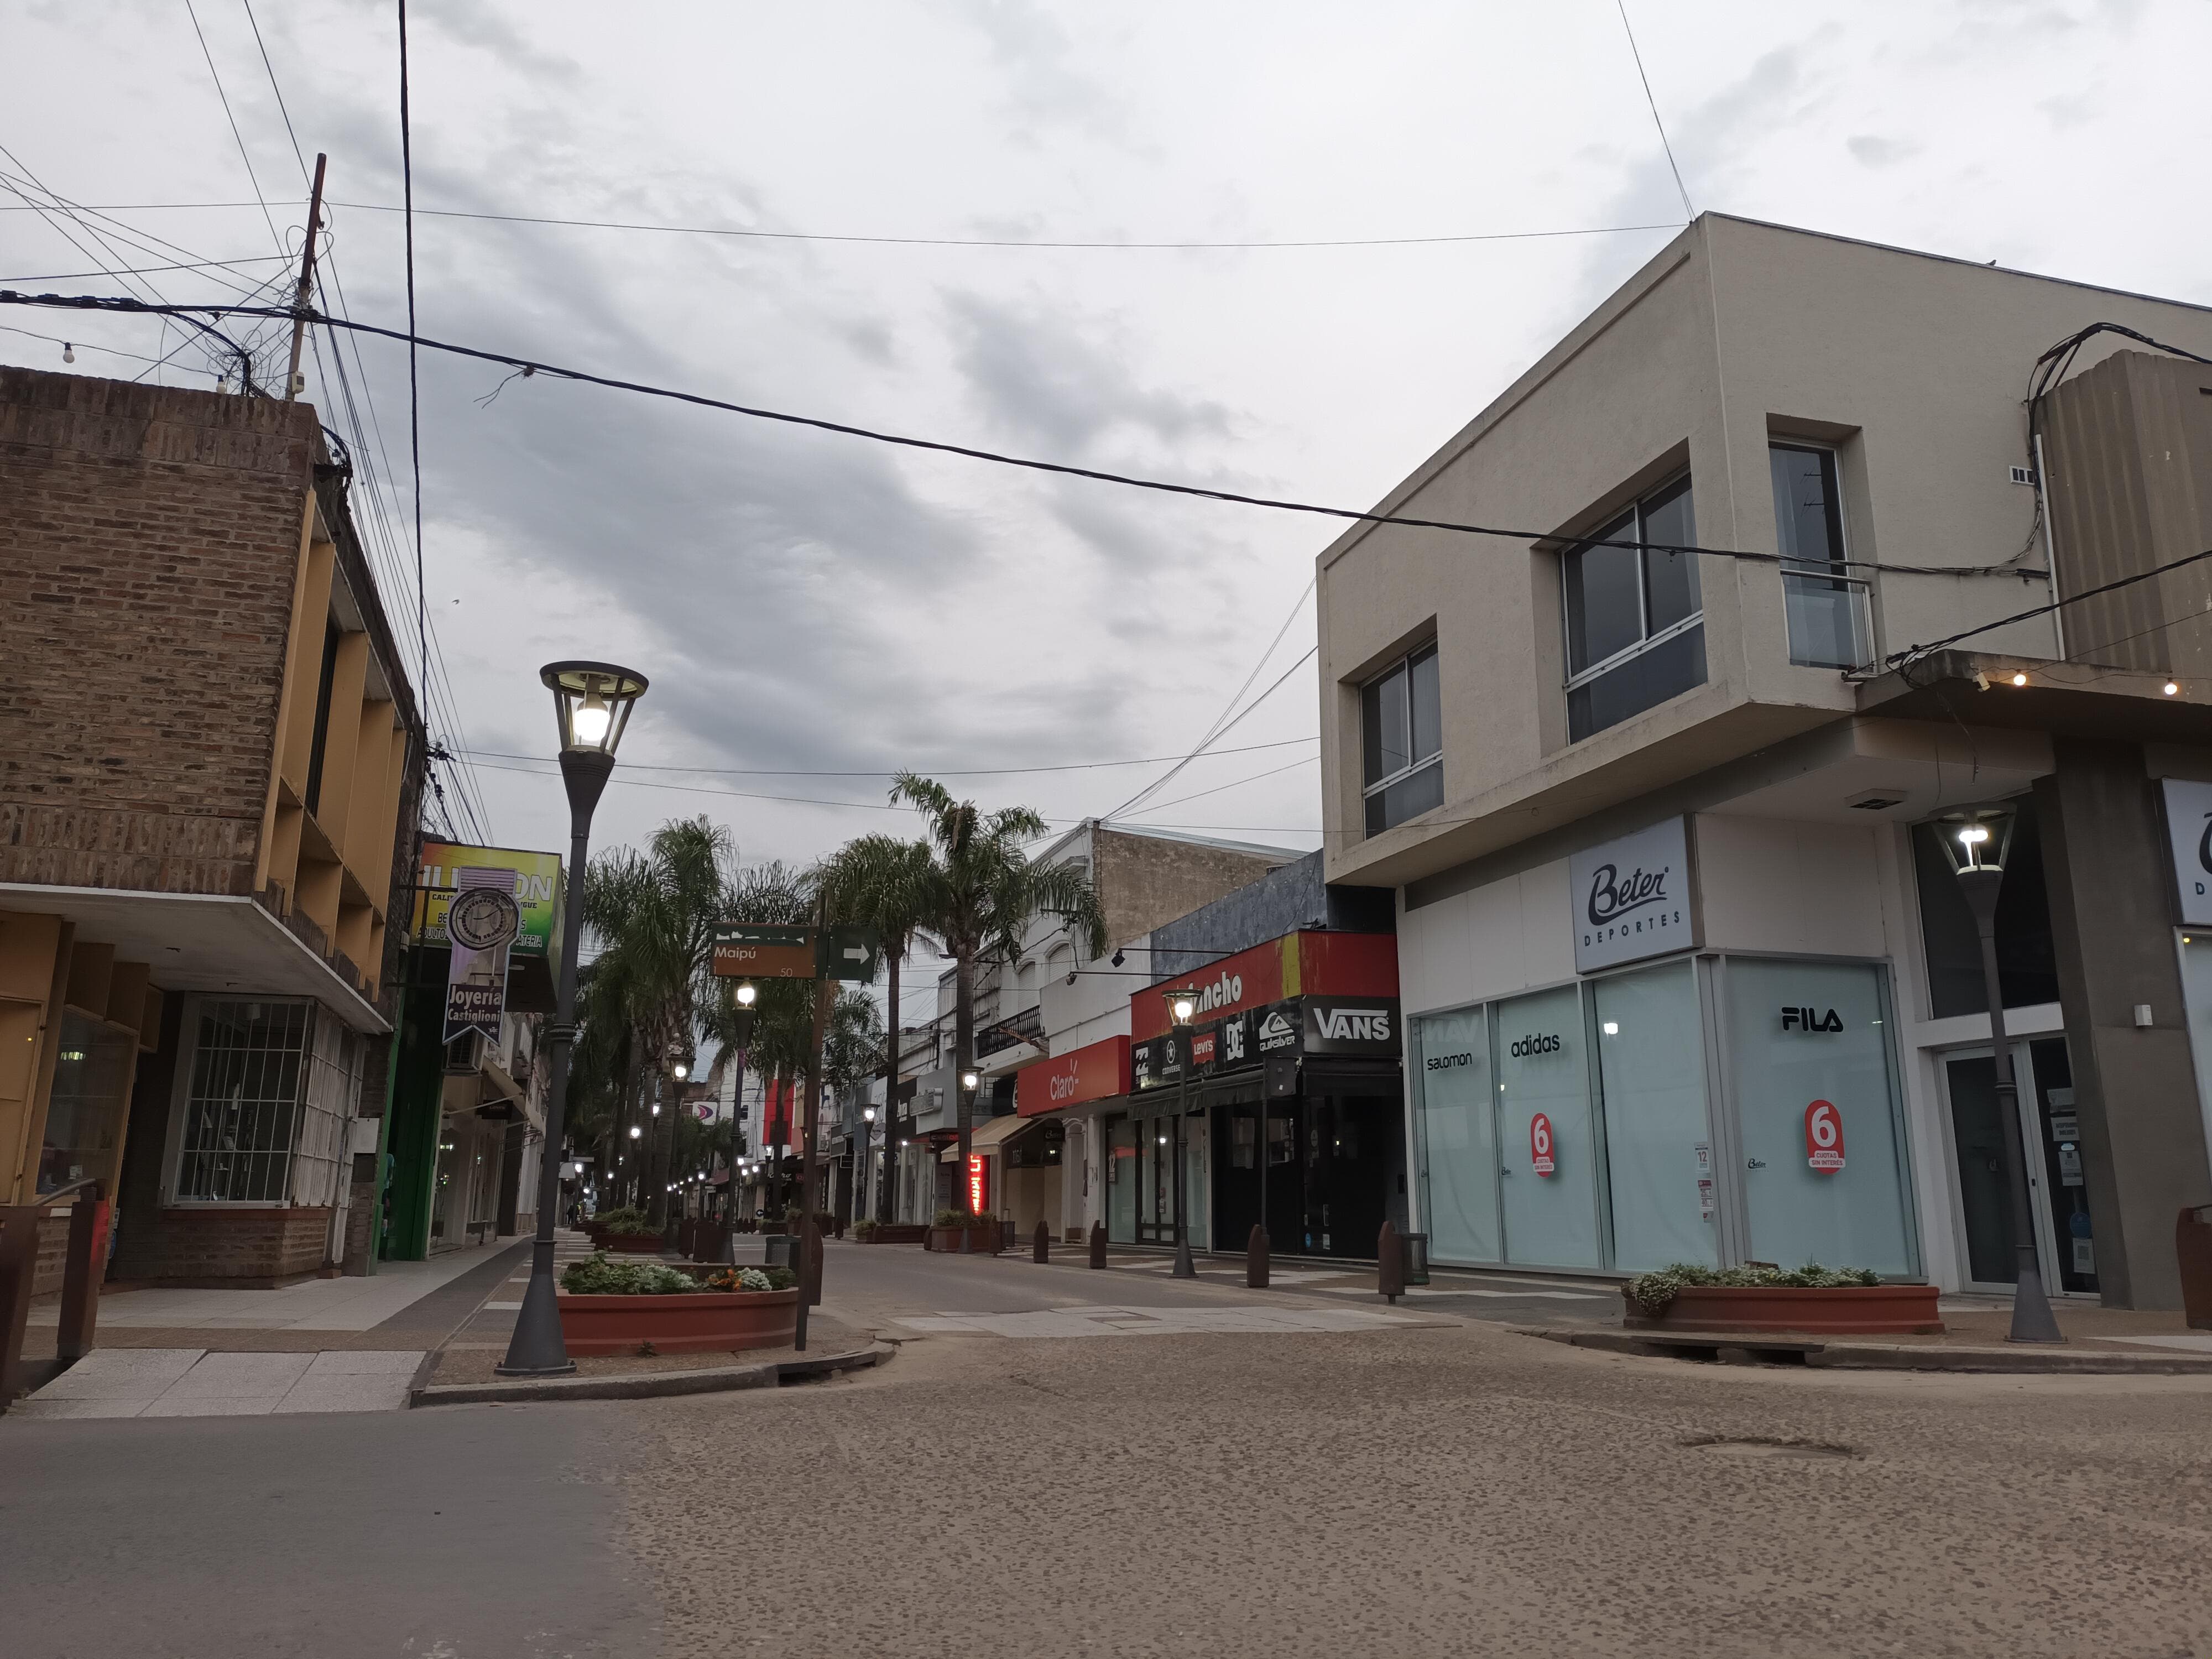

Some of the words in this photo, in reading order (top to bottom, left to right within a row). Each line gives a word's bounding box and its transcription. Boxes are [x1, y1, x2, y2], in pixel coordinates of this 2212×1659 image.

[1584, 910, 1680, 946] DEPORTES
[714, 946, 757, 961] Maipú
[780, 968, 793, 977] 50
[449, 985, 502, 1010] Joyería
[447, 1008, 500, 1023] Castiglioni
[1313, 1008, 1391, 1040] VANS
[1781, 1006, 1844, 1033] FILA
[1511, 1033, 1561, 1058] adidas
[1162, 1064, 1181, 1076] CONVERSE
[1427, 1052, 1473, 1071] salomon
[1050, 1074, 1074, 1100] Claro
[1534, 1118, 1549, 1154] 6
[1811, 1106, 1837, 1147] 6
[1698, 1151, 1708, 1162] 12
